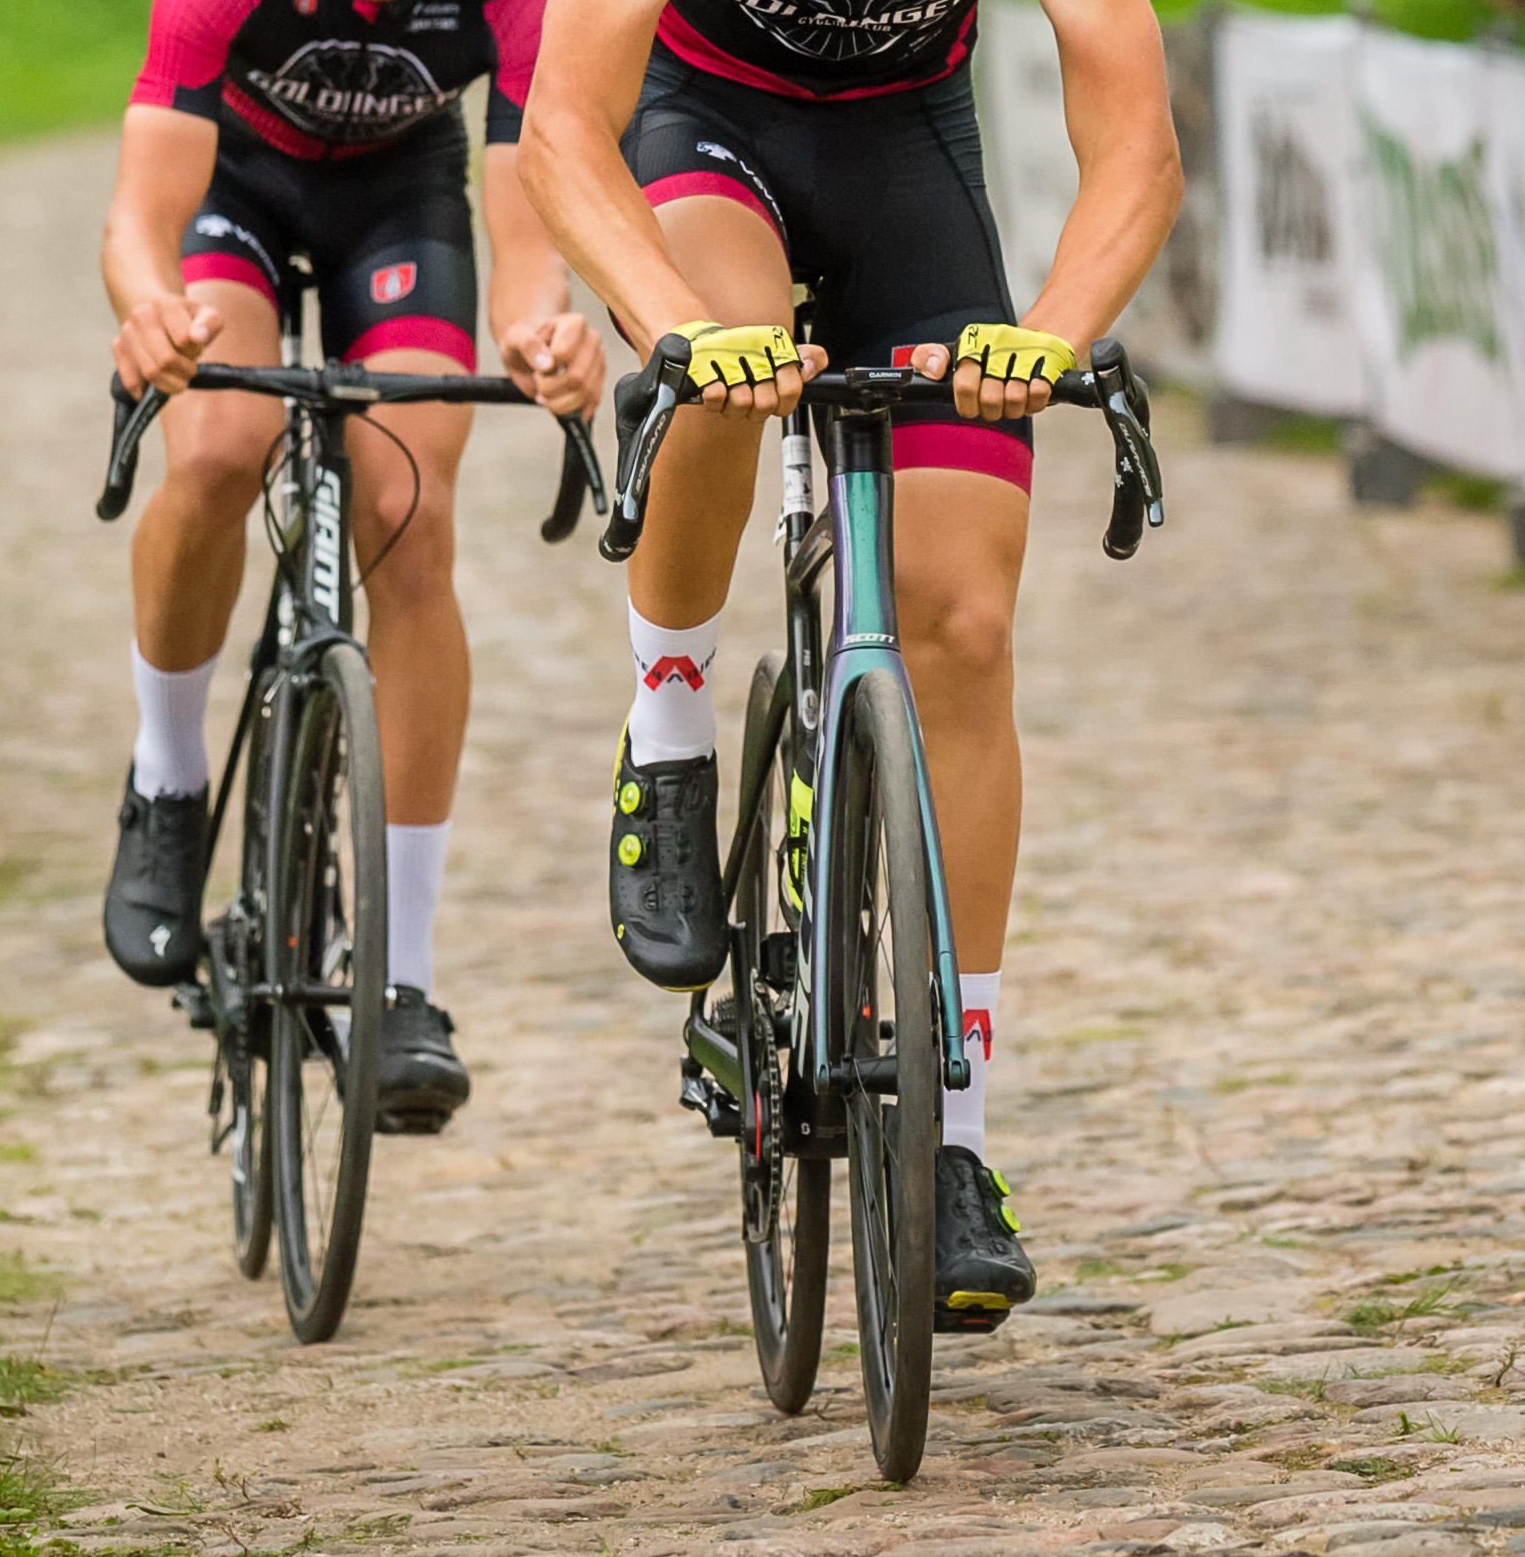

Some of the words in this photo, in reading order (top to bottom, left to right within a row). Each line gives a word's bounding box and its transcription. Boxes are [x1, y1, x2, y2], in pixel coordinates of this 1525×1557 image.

[868, 371, 902, 379] GARMIN
[314, 464, 342, 625] GIANT
[844, 633, 896, 645] SCOTT
